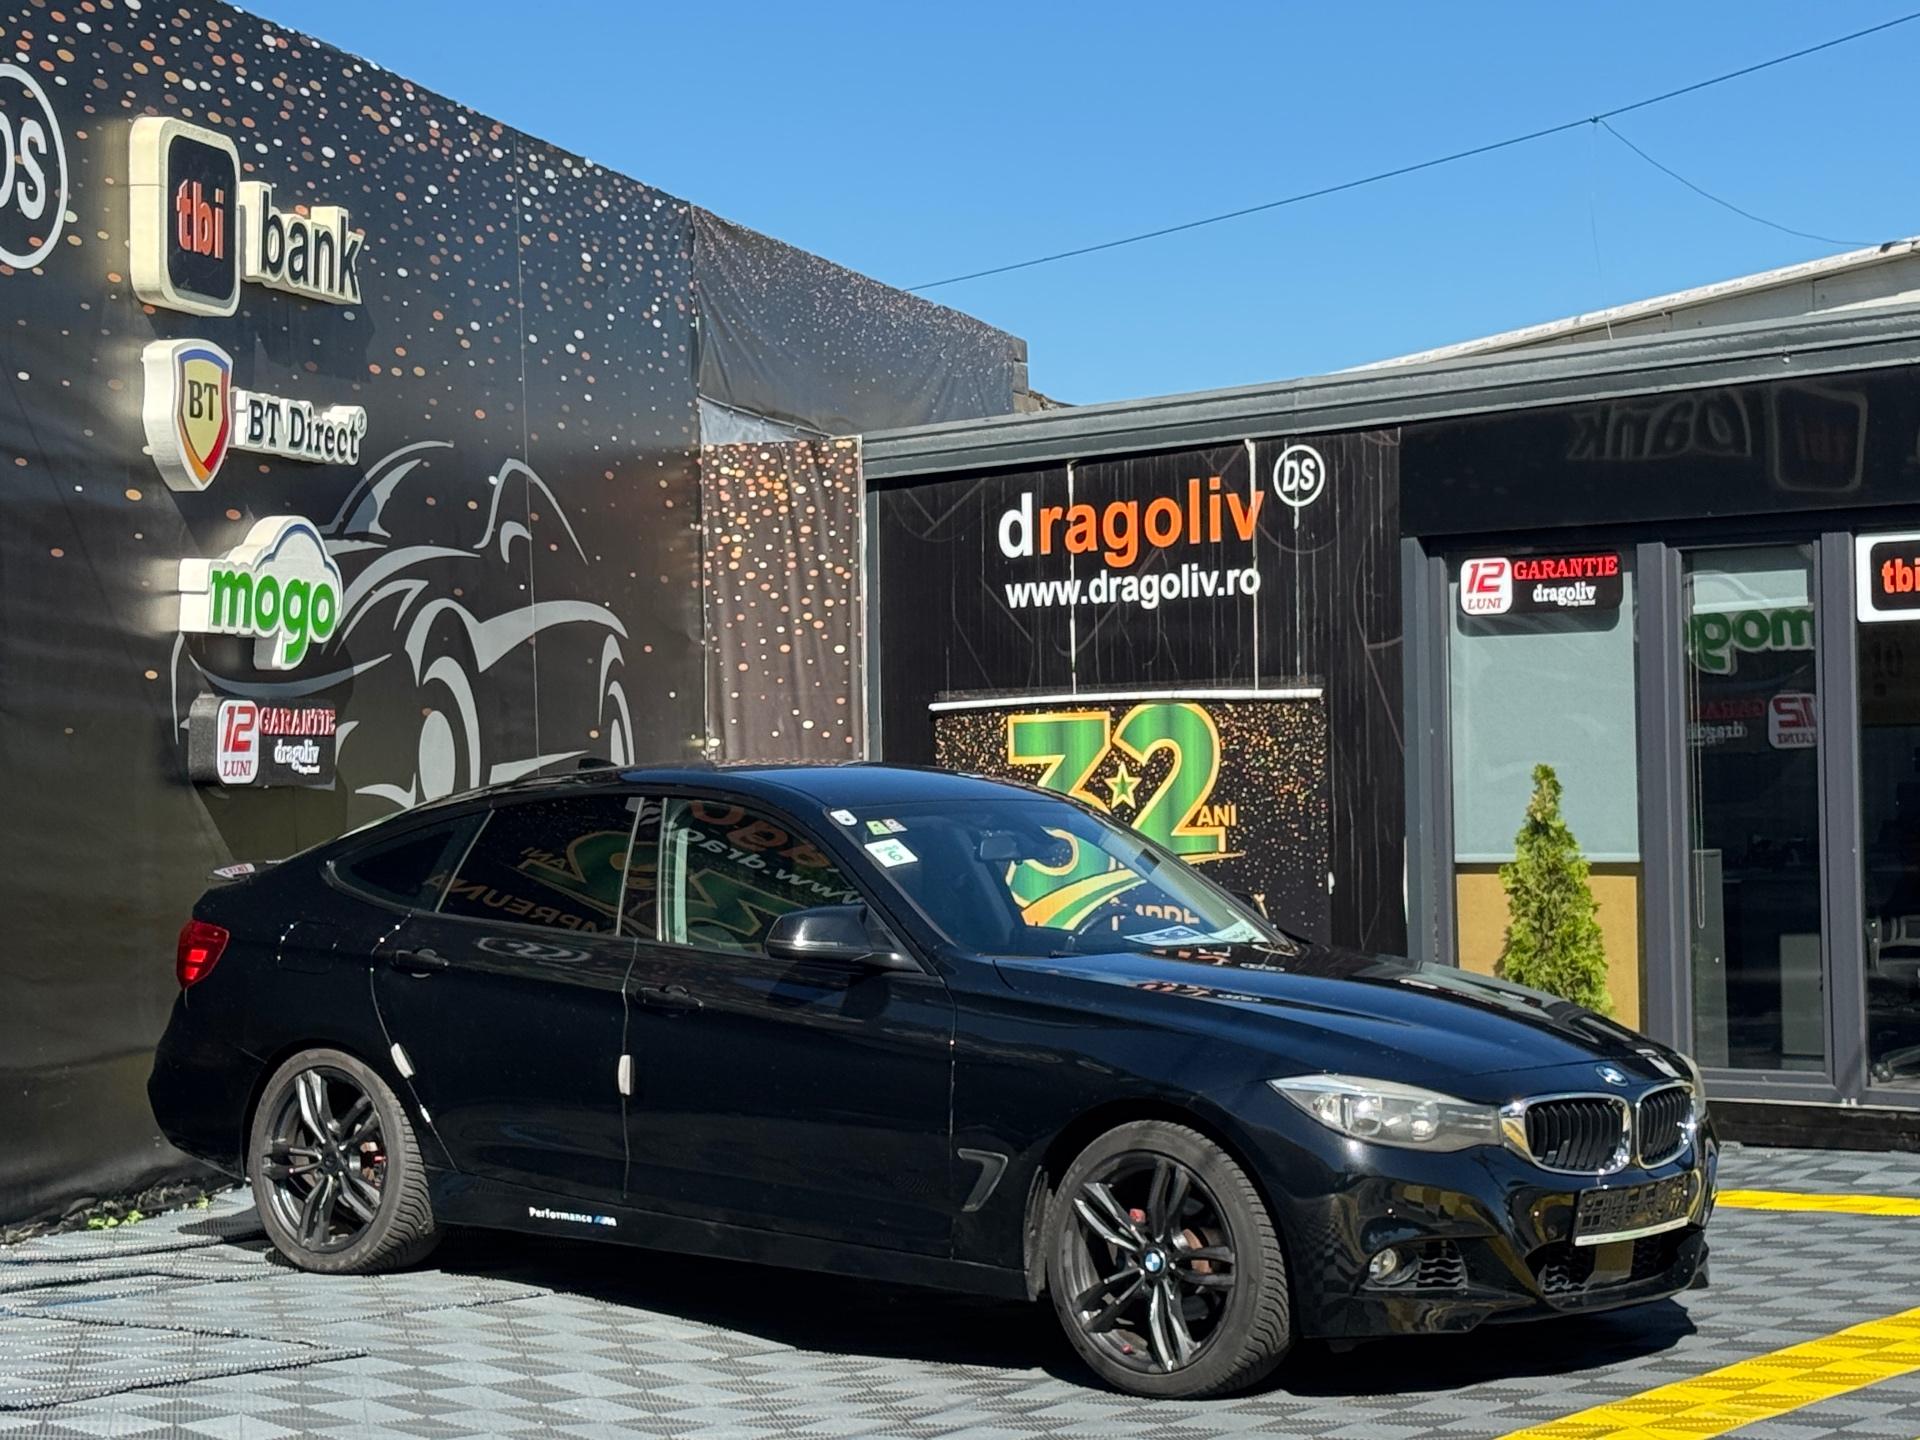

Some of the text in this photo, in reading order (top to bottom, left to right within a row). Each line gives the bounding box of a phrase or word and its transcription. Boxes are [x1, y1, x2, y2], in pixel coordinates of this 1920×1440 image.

[176, 178, 363, 304] tbi bank
[188, 380, 218, 421] BT
[248, 399, 358, 460] BT Direct
[1283, 458, 1316, 492] DS
[998, 476, 1265, 568] dragoliv
[1005, 563, 1262, 609] www.dragoliv.ro
[1467, 555, 1619, 595] 12 GARANTIE
[1532, 581, 1597, 606] dragoliv
[211, 569, 336, 665] mogo
[1467, 597, 1503, 610] LUNI
[223, 706, 336, 752] 12 GARANTIE
[223, 760, 252, 777] LUNI
[274, 738, 320, 771] dragoliv
[1196, 803, 1237, 827] ANI
[528, 1206, 593, 1224] Performance
